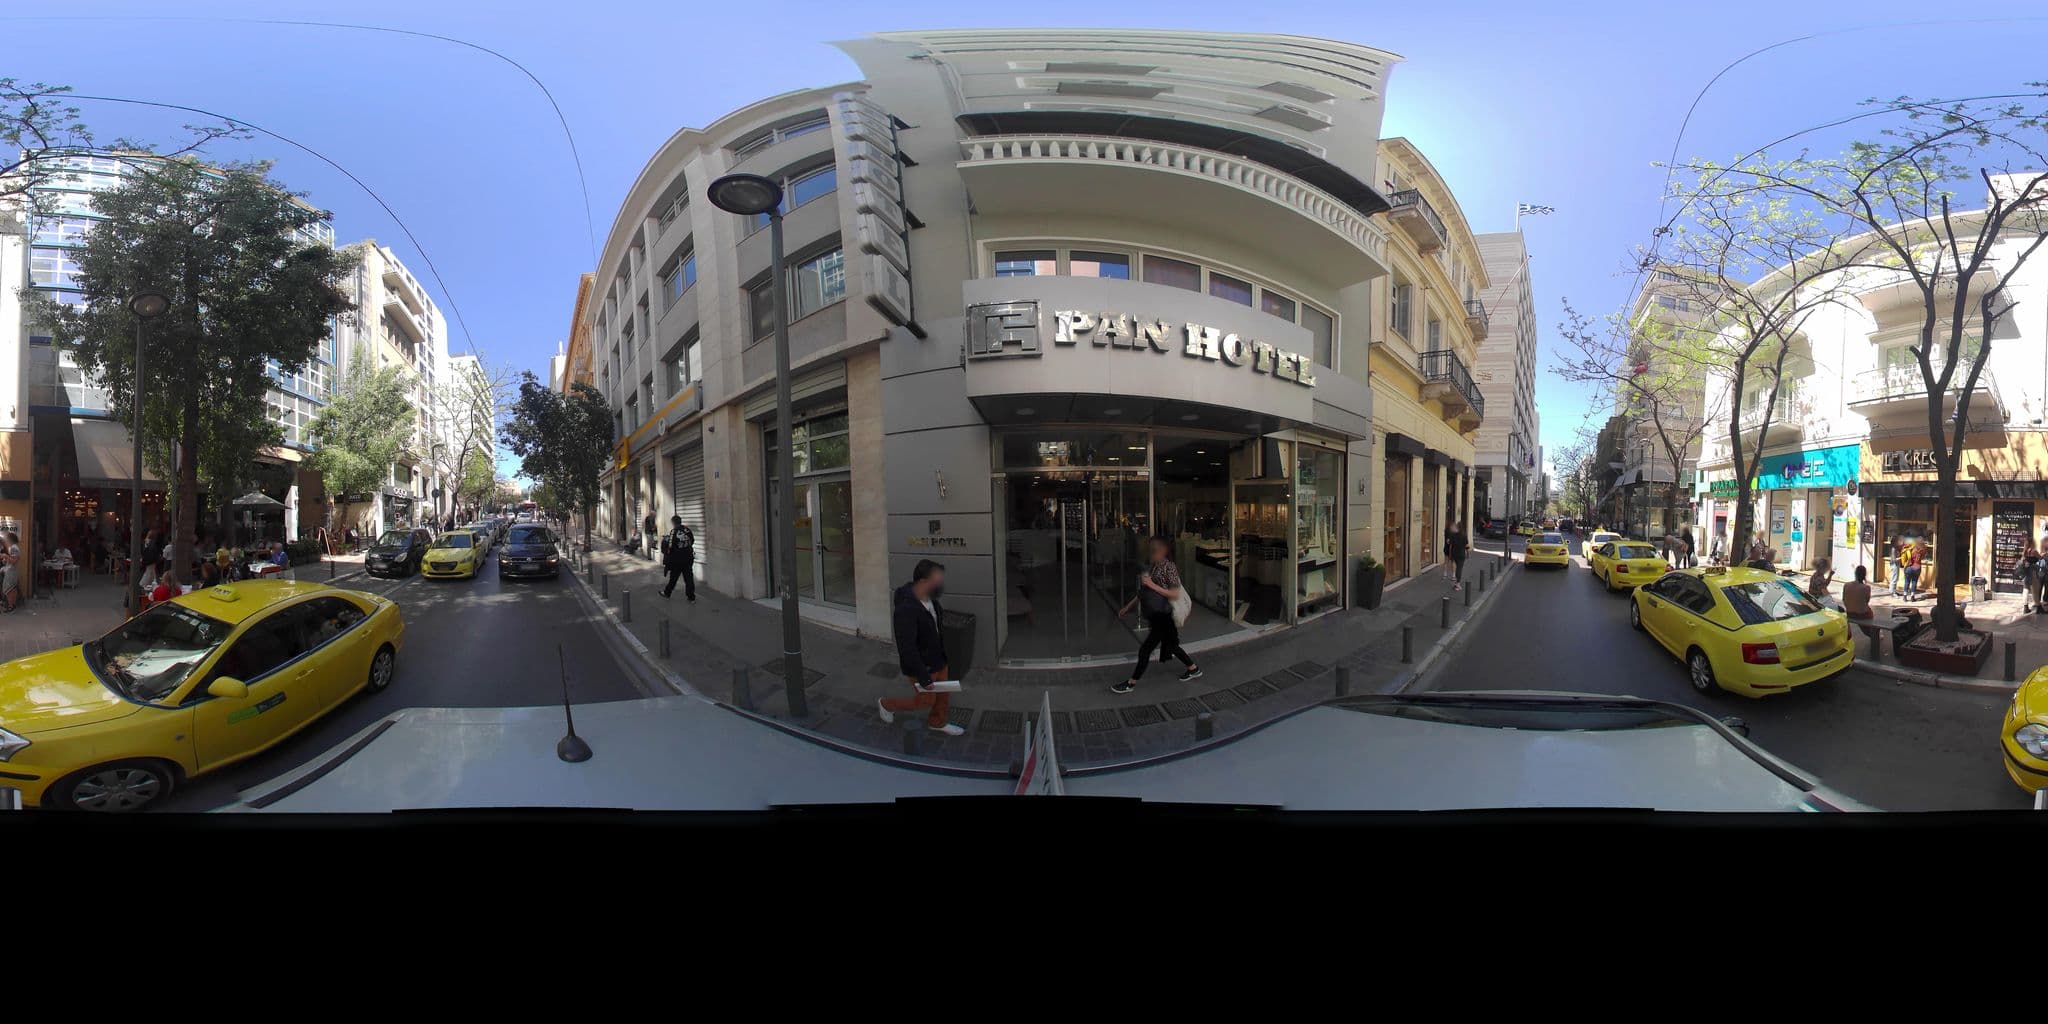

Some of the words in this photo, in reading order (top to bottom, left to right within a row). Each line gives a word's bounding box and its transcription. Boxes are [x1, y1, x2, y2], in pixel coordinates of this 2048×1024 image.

[1055, 310, 1169, 352] PAN
[1184, 322, 1316, 388] HOTEL
[931, 536, 967, 547] HOTEL
